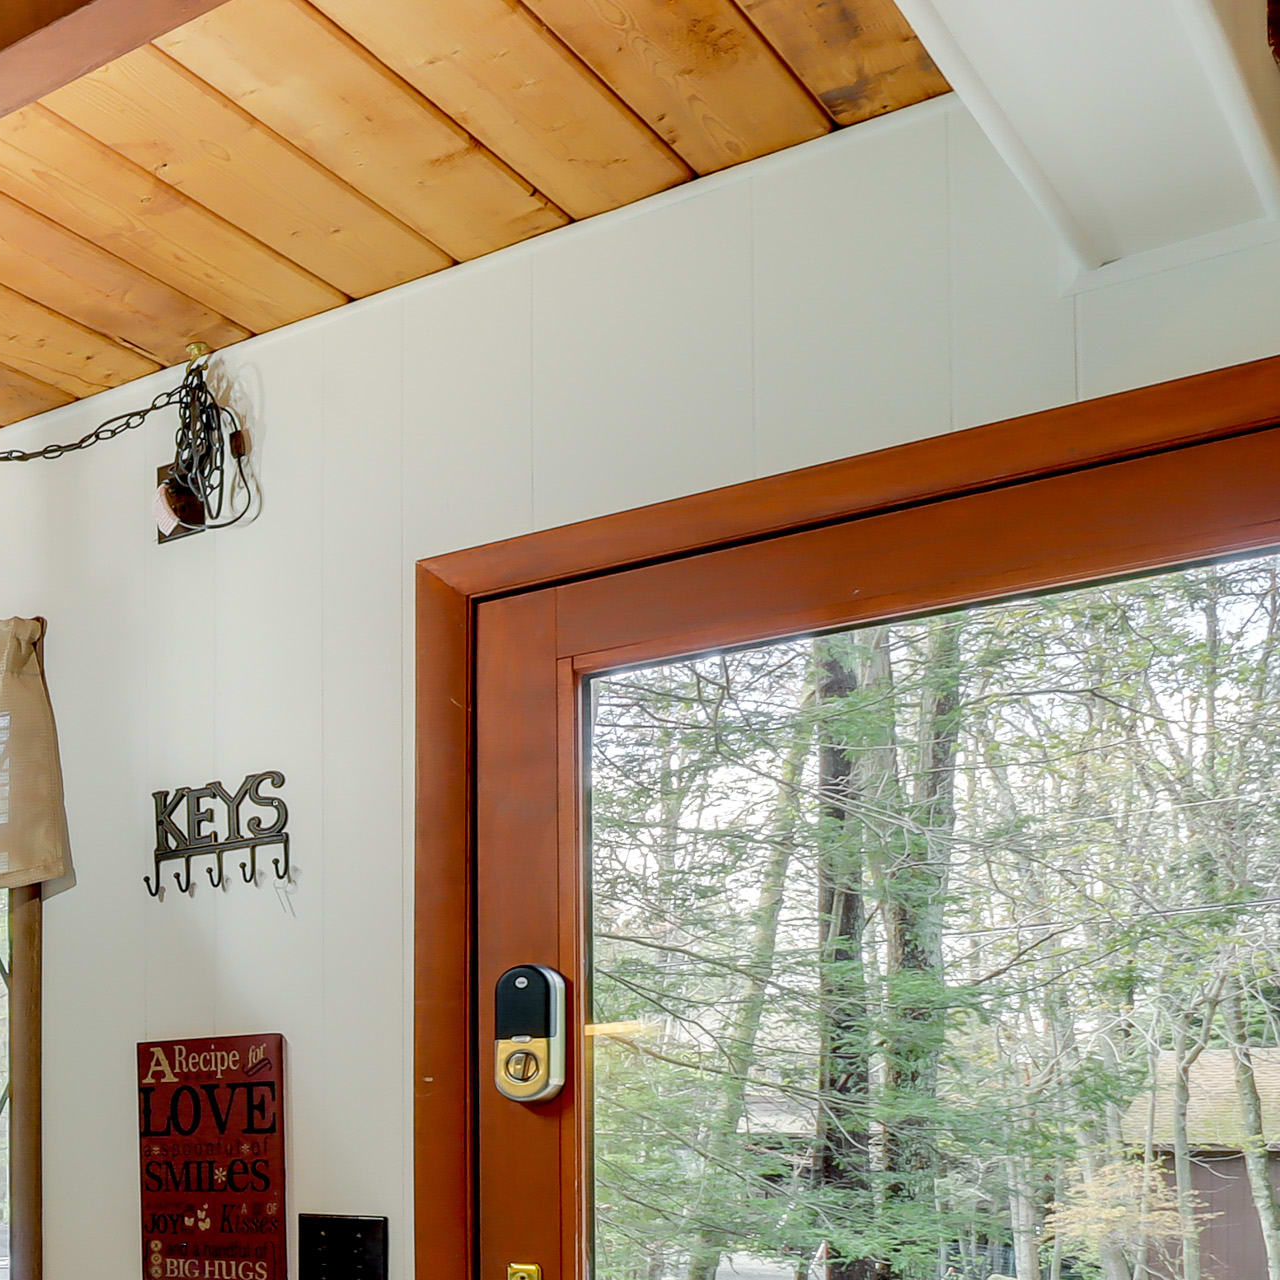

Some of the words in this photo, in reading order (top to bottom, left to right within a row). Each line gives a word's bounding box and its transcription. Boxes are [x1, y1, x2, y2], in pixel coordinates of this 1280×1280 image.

[152, 770, 289, 851] KEYS
[142, 1047, 179, 1083] A
[173, 1044, 240, 1079] Recipe
[247, 1043, 267, 1068] for
[140, 1081, 277, 1137] LOVE
[165, 1258, 200, 1278] BIG
